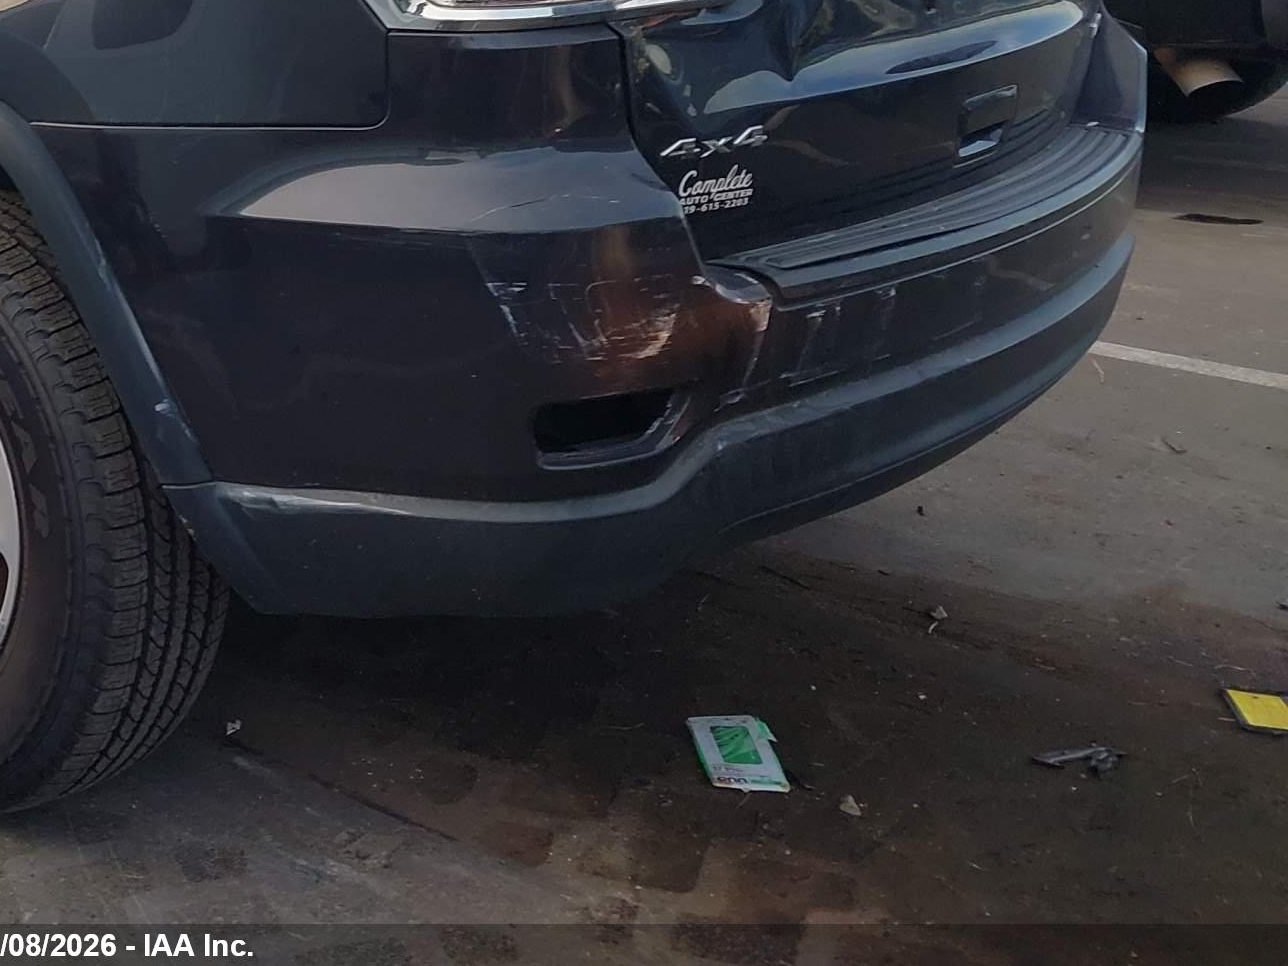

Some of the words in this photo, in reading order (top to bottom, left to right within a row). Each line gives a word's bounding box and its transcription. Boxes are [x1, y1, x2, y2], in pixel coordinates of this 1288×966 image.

[678, 164, 753, 198] Complete
[679, 194, 709, 206] AUTO
[712, 188, 754, 203] CENTER
[683, 197, 749, 214] 19-615-2203
